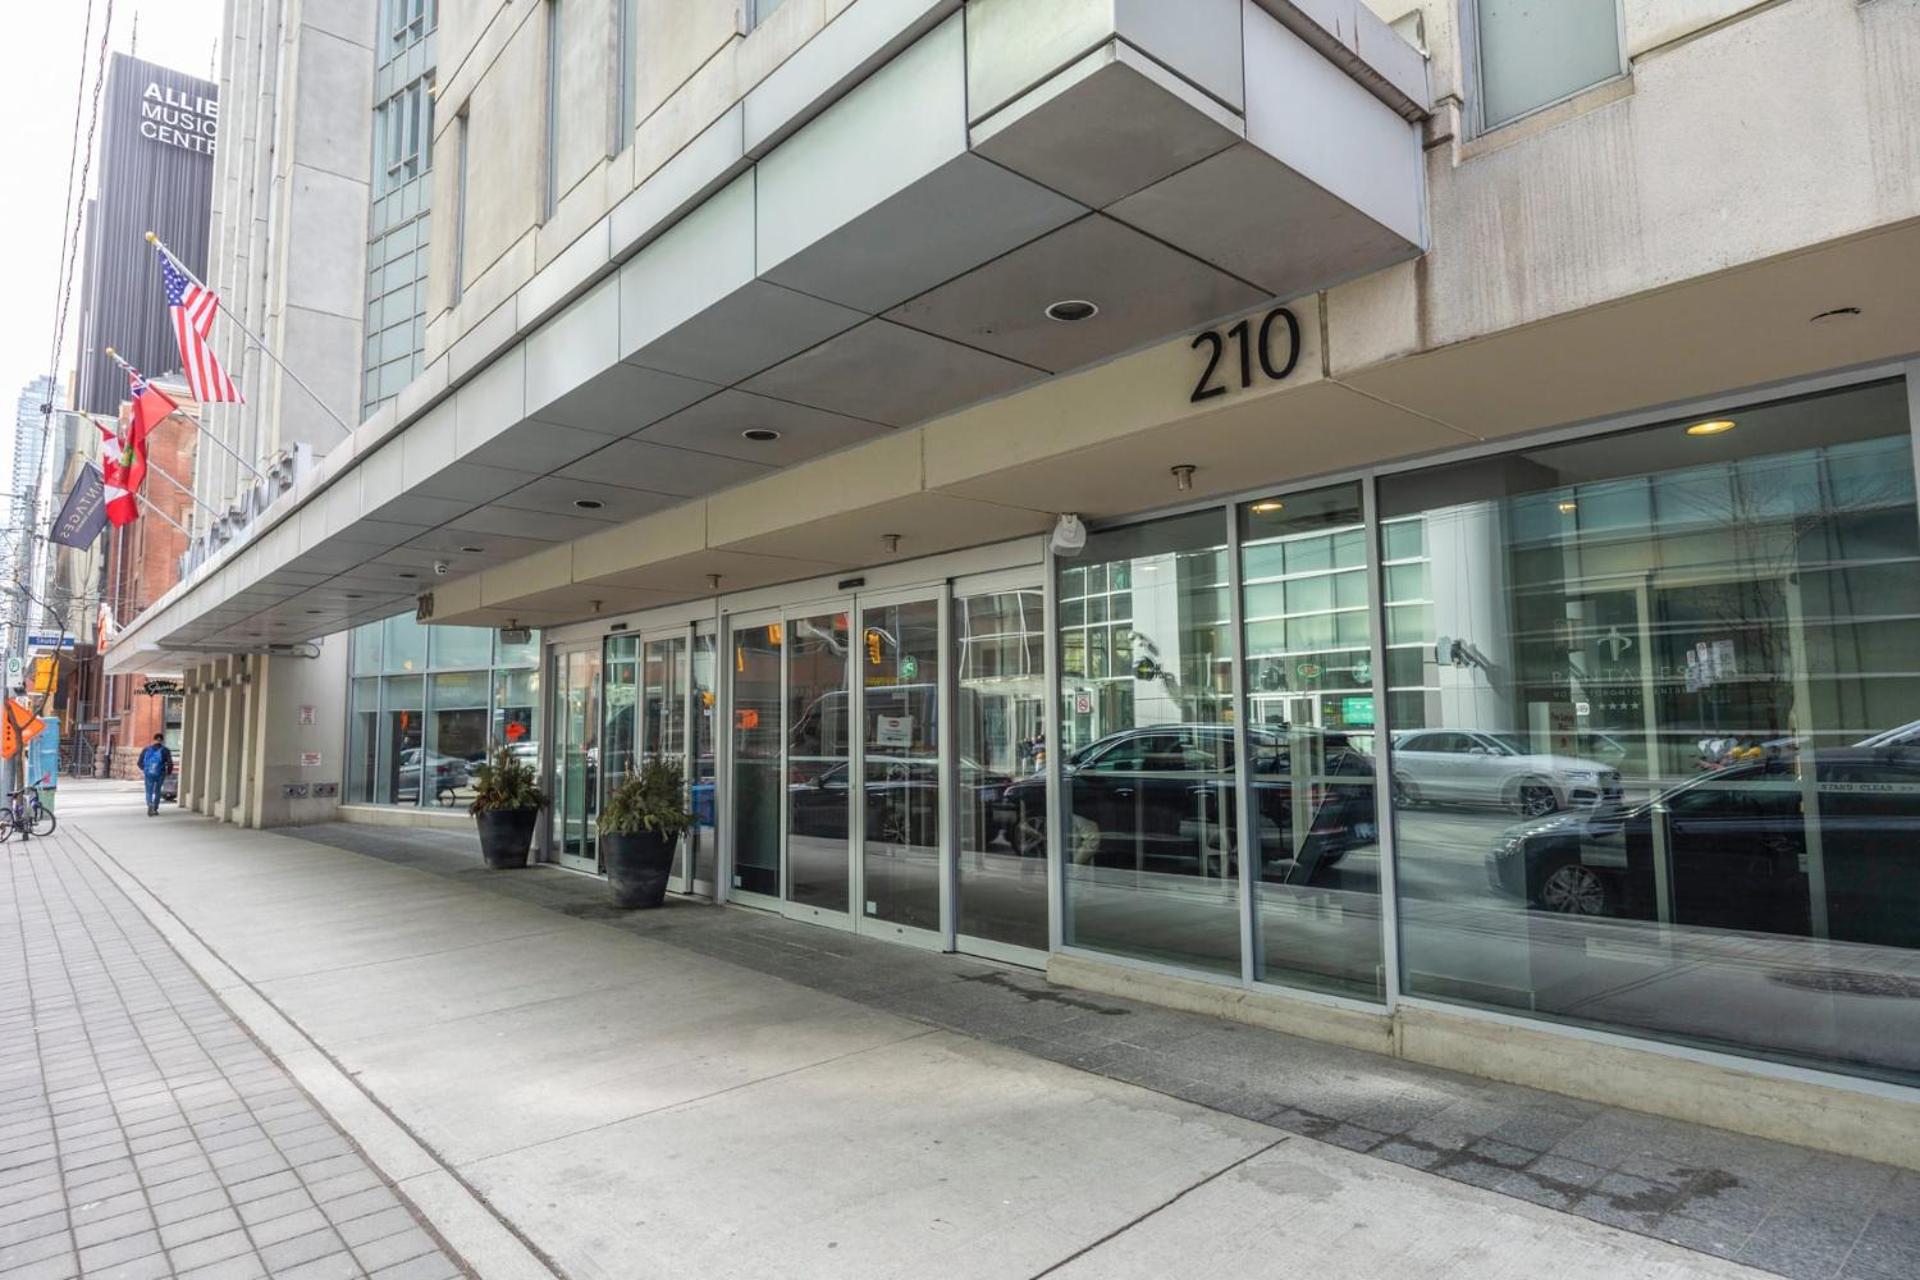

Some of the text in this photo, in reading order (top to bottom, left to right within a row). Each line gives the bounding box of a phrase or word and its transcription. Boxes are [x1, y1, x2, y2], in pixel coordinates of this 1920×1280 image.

[143, 82, 219, 118] ALLIE
[1190, 307, 1300, 403] 210
[1551, 666, 1690, 686] PNTAES
